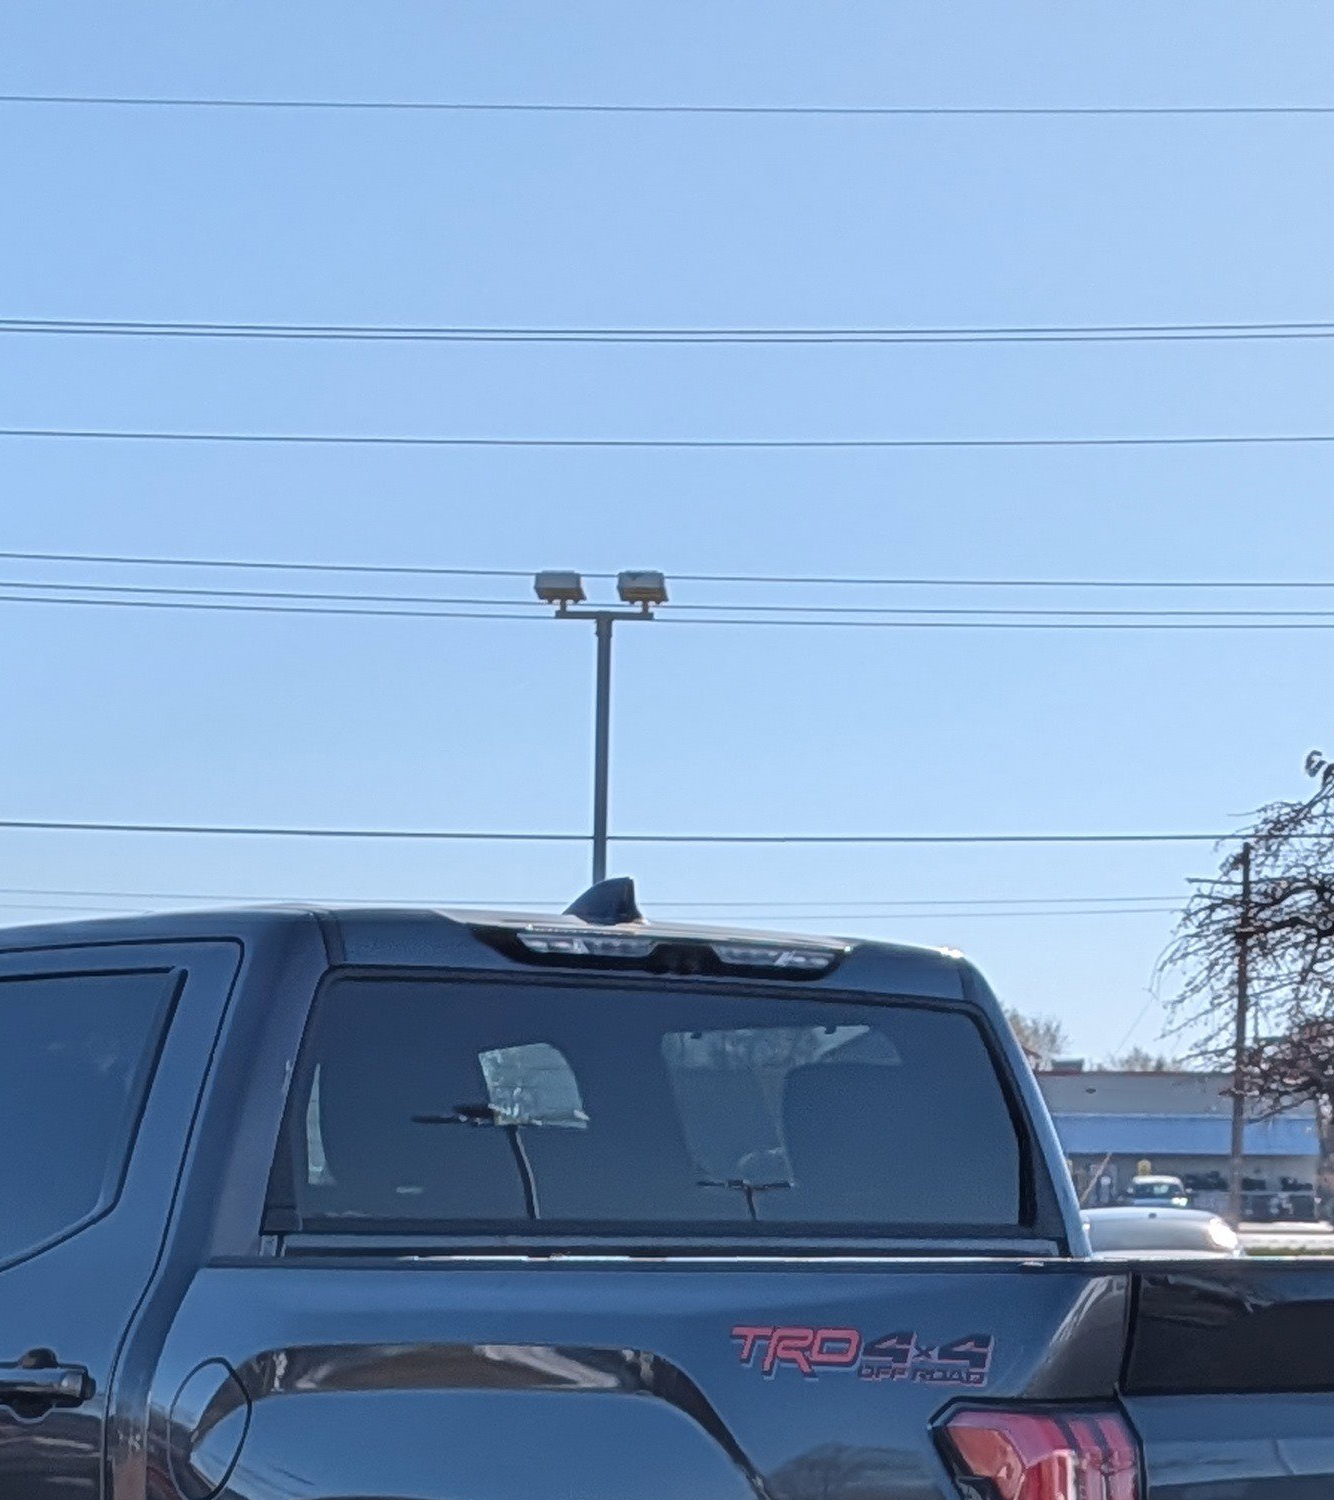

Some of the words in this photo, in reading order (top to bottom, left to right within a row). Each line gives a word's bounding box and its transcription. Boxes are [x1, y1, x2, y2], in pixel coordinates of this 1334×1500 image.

[730, 1325, 863, 1380] TRD
[858, 1365, 910, 1382] OFF
[912, 1367, 989, 1388] ROAD
